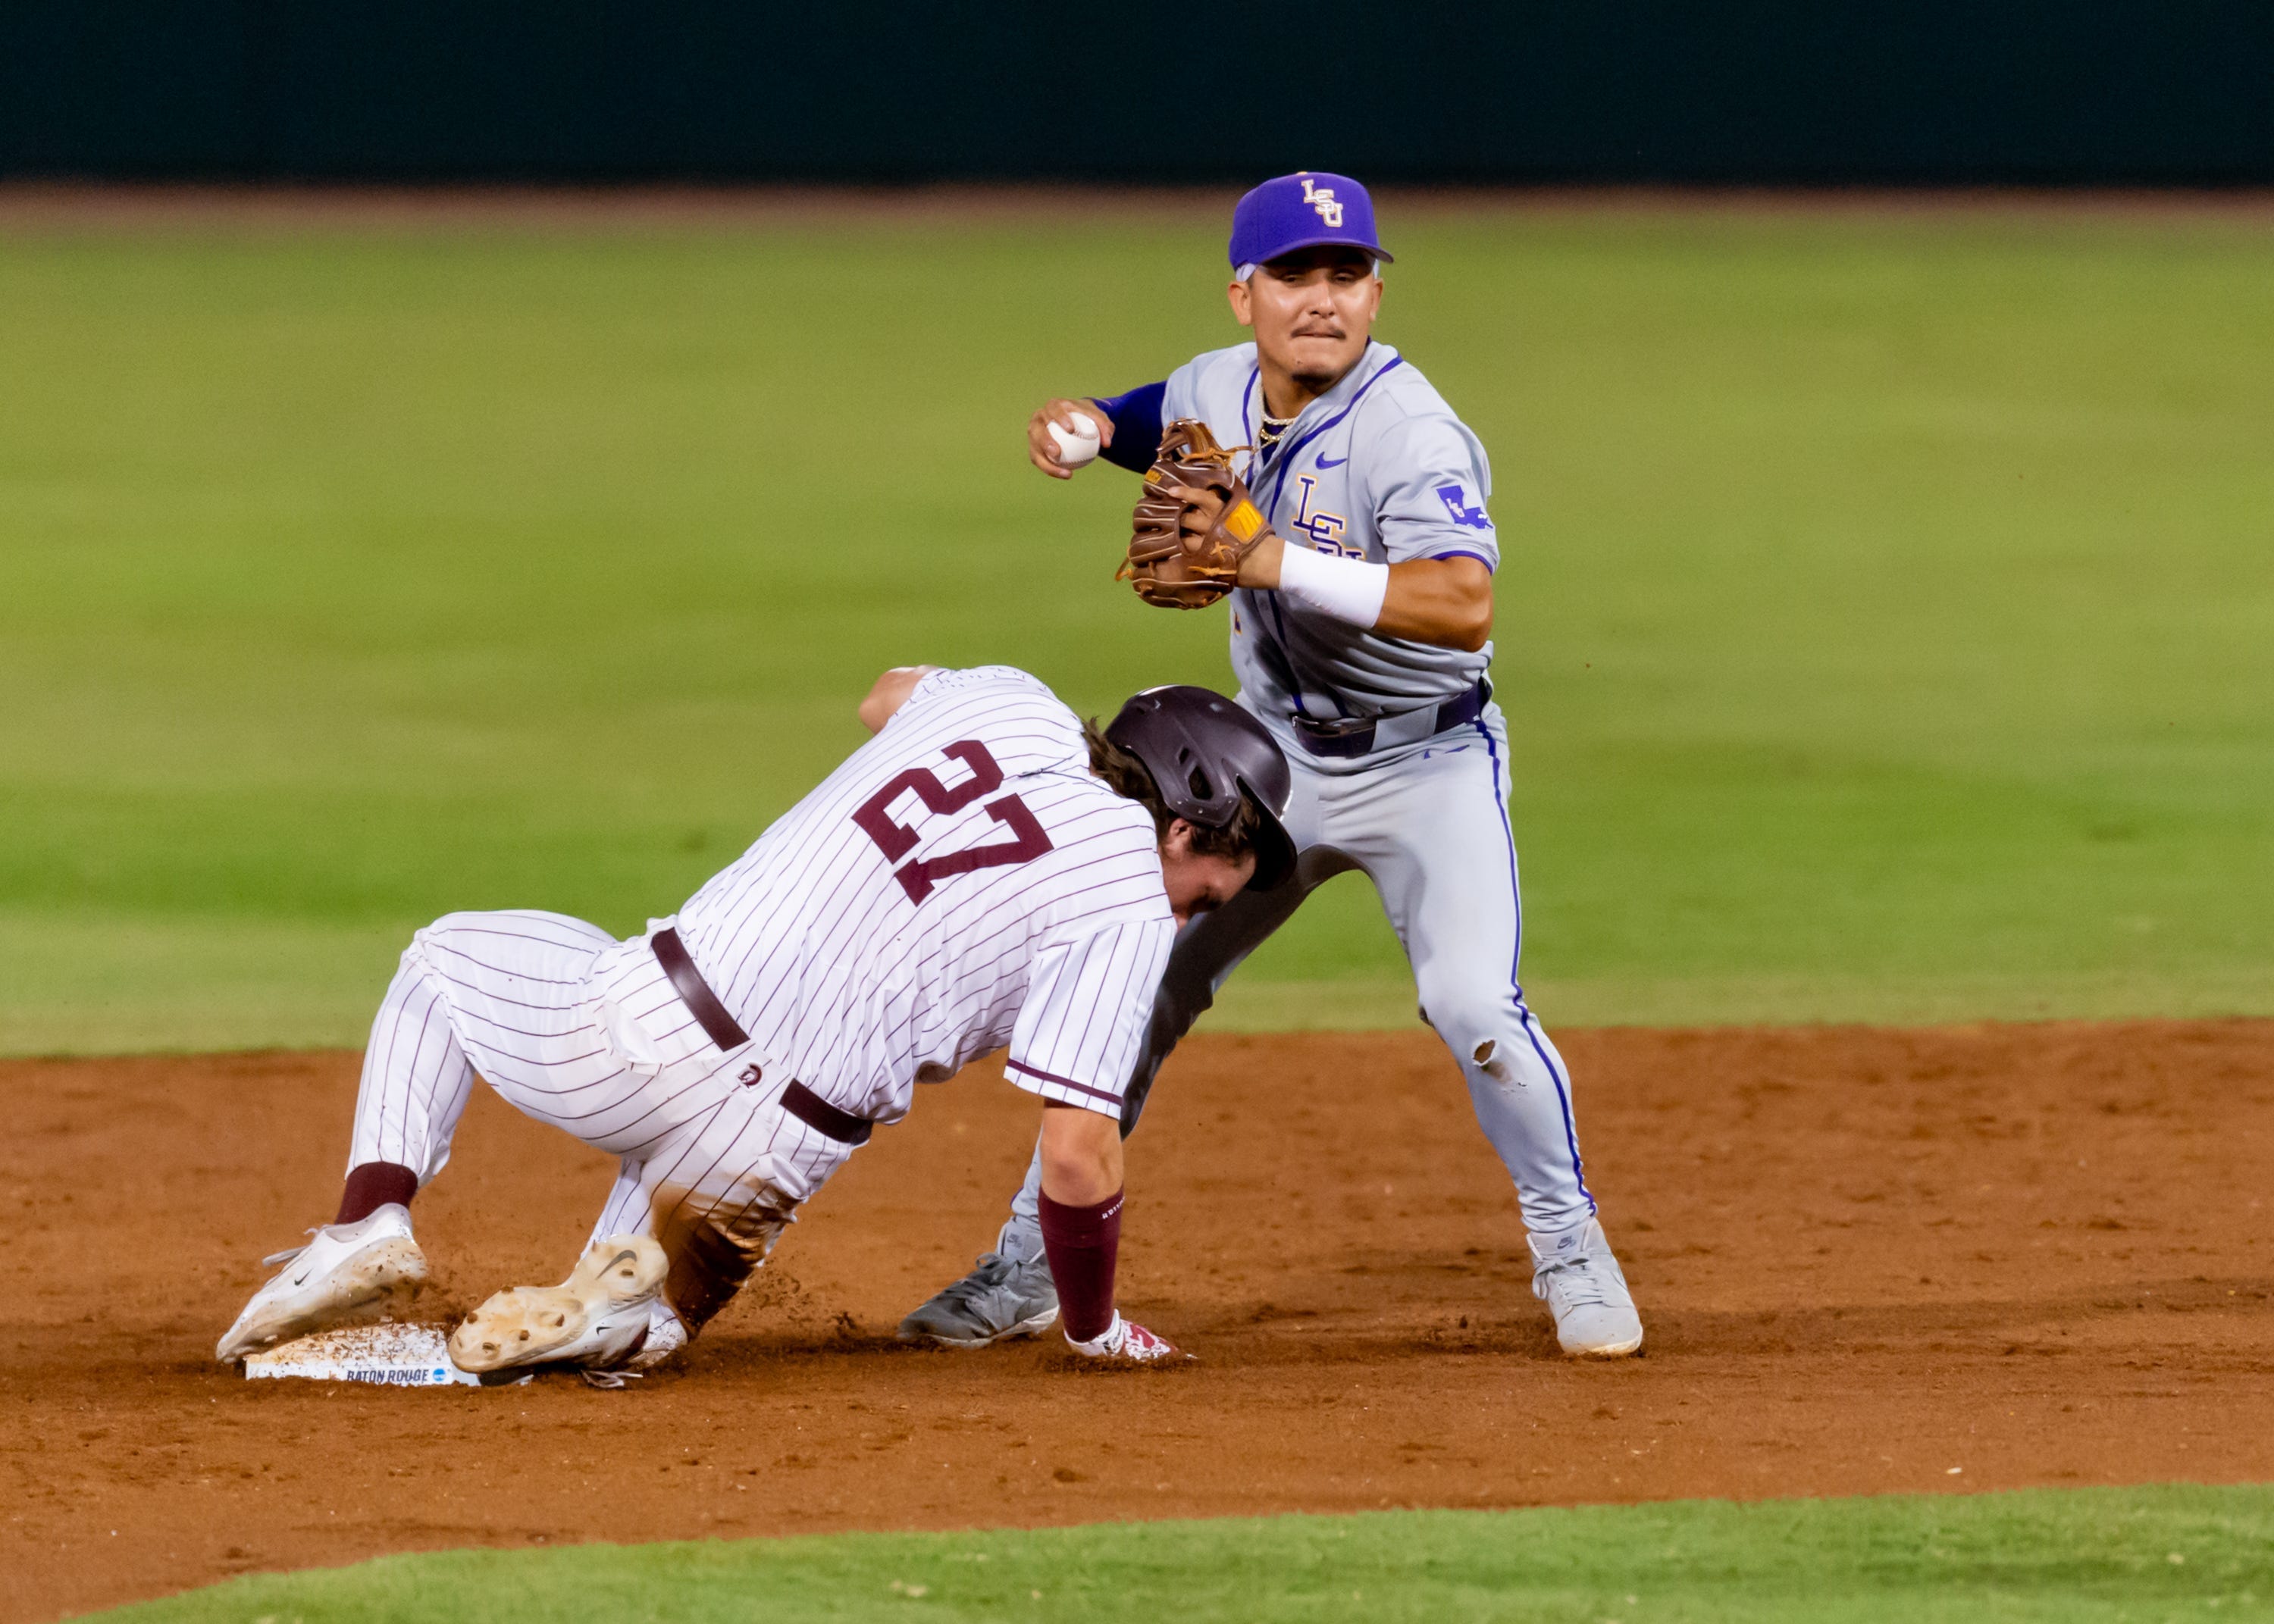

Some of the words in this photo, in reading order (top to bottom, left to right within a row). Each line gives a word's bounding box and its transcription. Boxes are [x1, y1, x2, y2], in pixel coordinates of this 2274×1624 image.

[1301, 179, 1343, 227] LSU
[1290, 473, 1367, 562] LS
[850, 740, 1054, 908] 27
[347, 1369, 384, 1383] BATON
[387, 1369, 429, 1383] ROUGE
